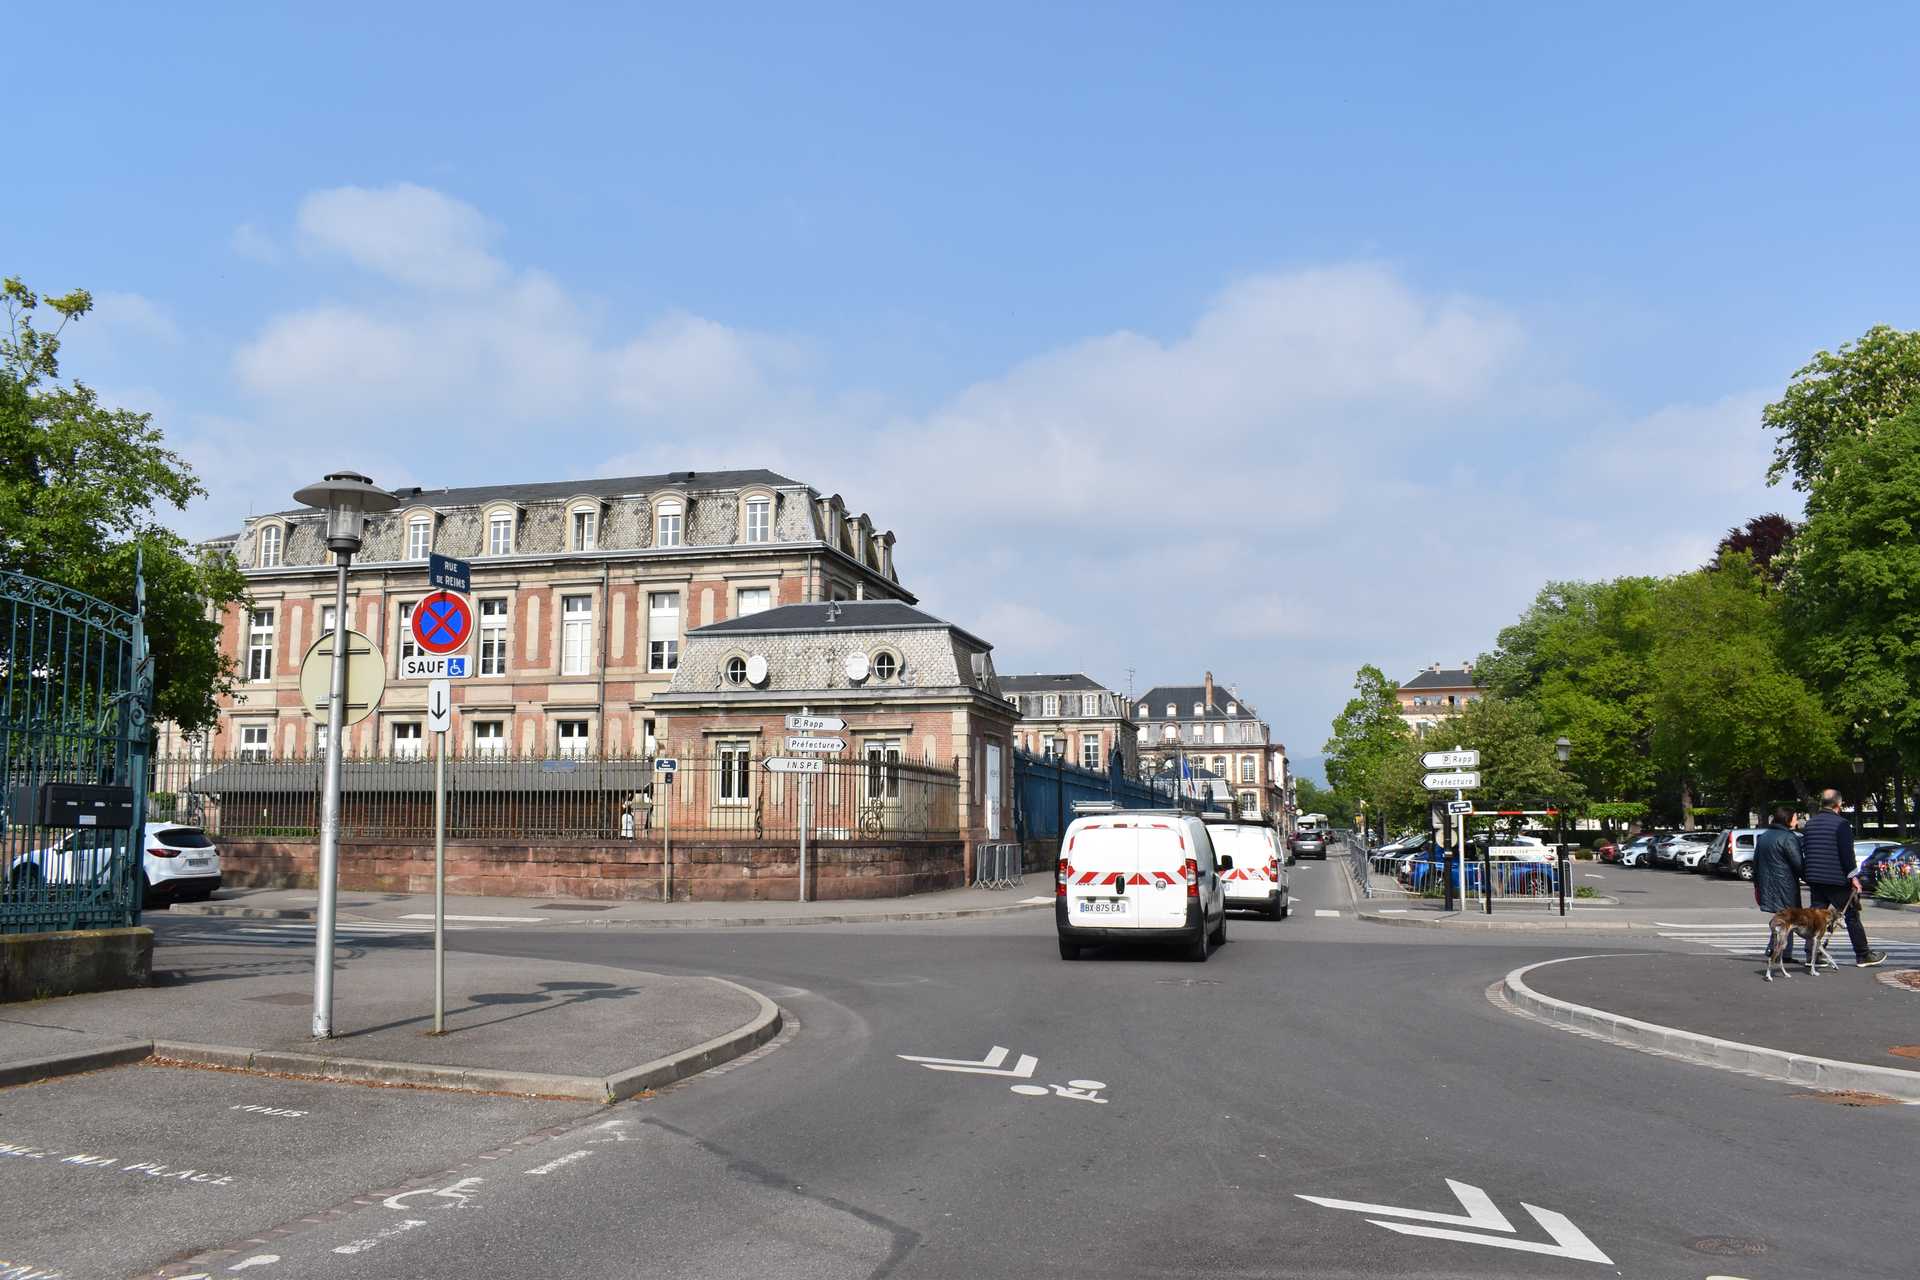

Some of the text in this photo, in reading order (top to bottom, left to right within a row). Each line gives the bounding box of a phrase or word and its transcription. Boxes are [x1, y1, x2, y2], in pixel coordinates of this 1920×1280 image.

[444, 561, 458, 572] RUE
[436, 575, 466, 589] DE REIMS
[407, 660, 445, 673] SAUF
[803, 720, 824, 729] Rapp
[791, 740, 835, 749] Préfecture
[1452, 755, 1472, 764] Rapp
[1432, 778, 1473, 786] Préfecture
